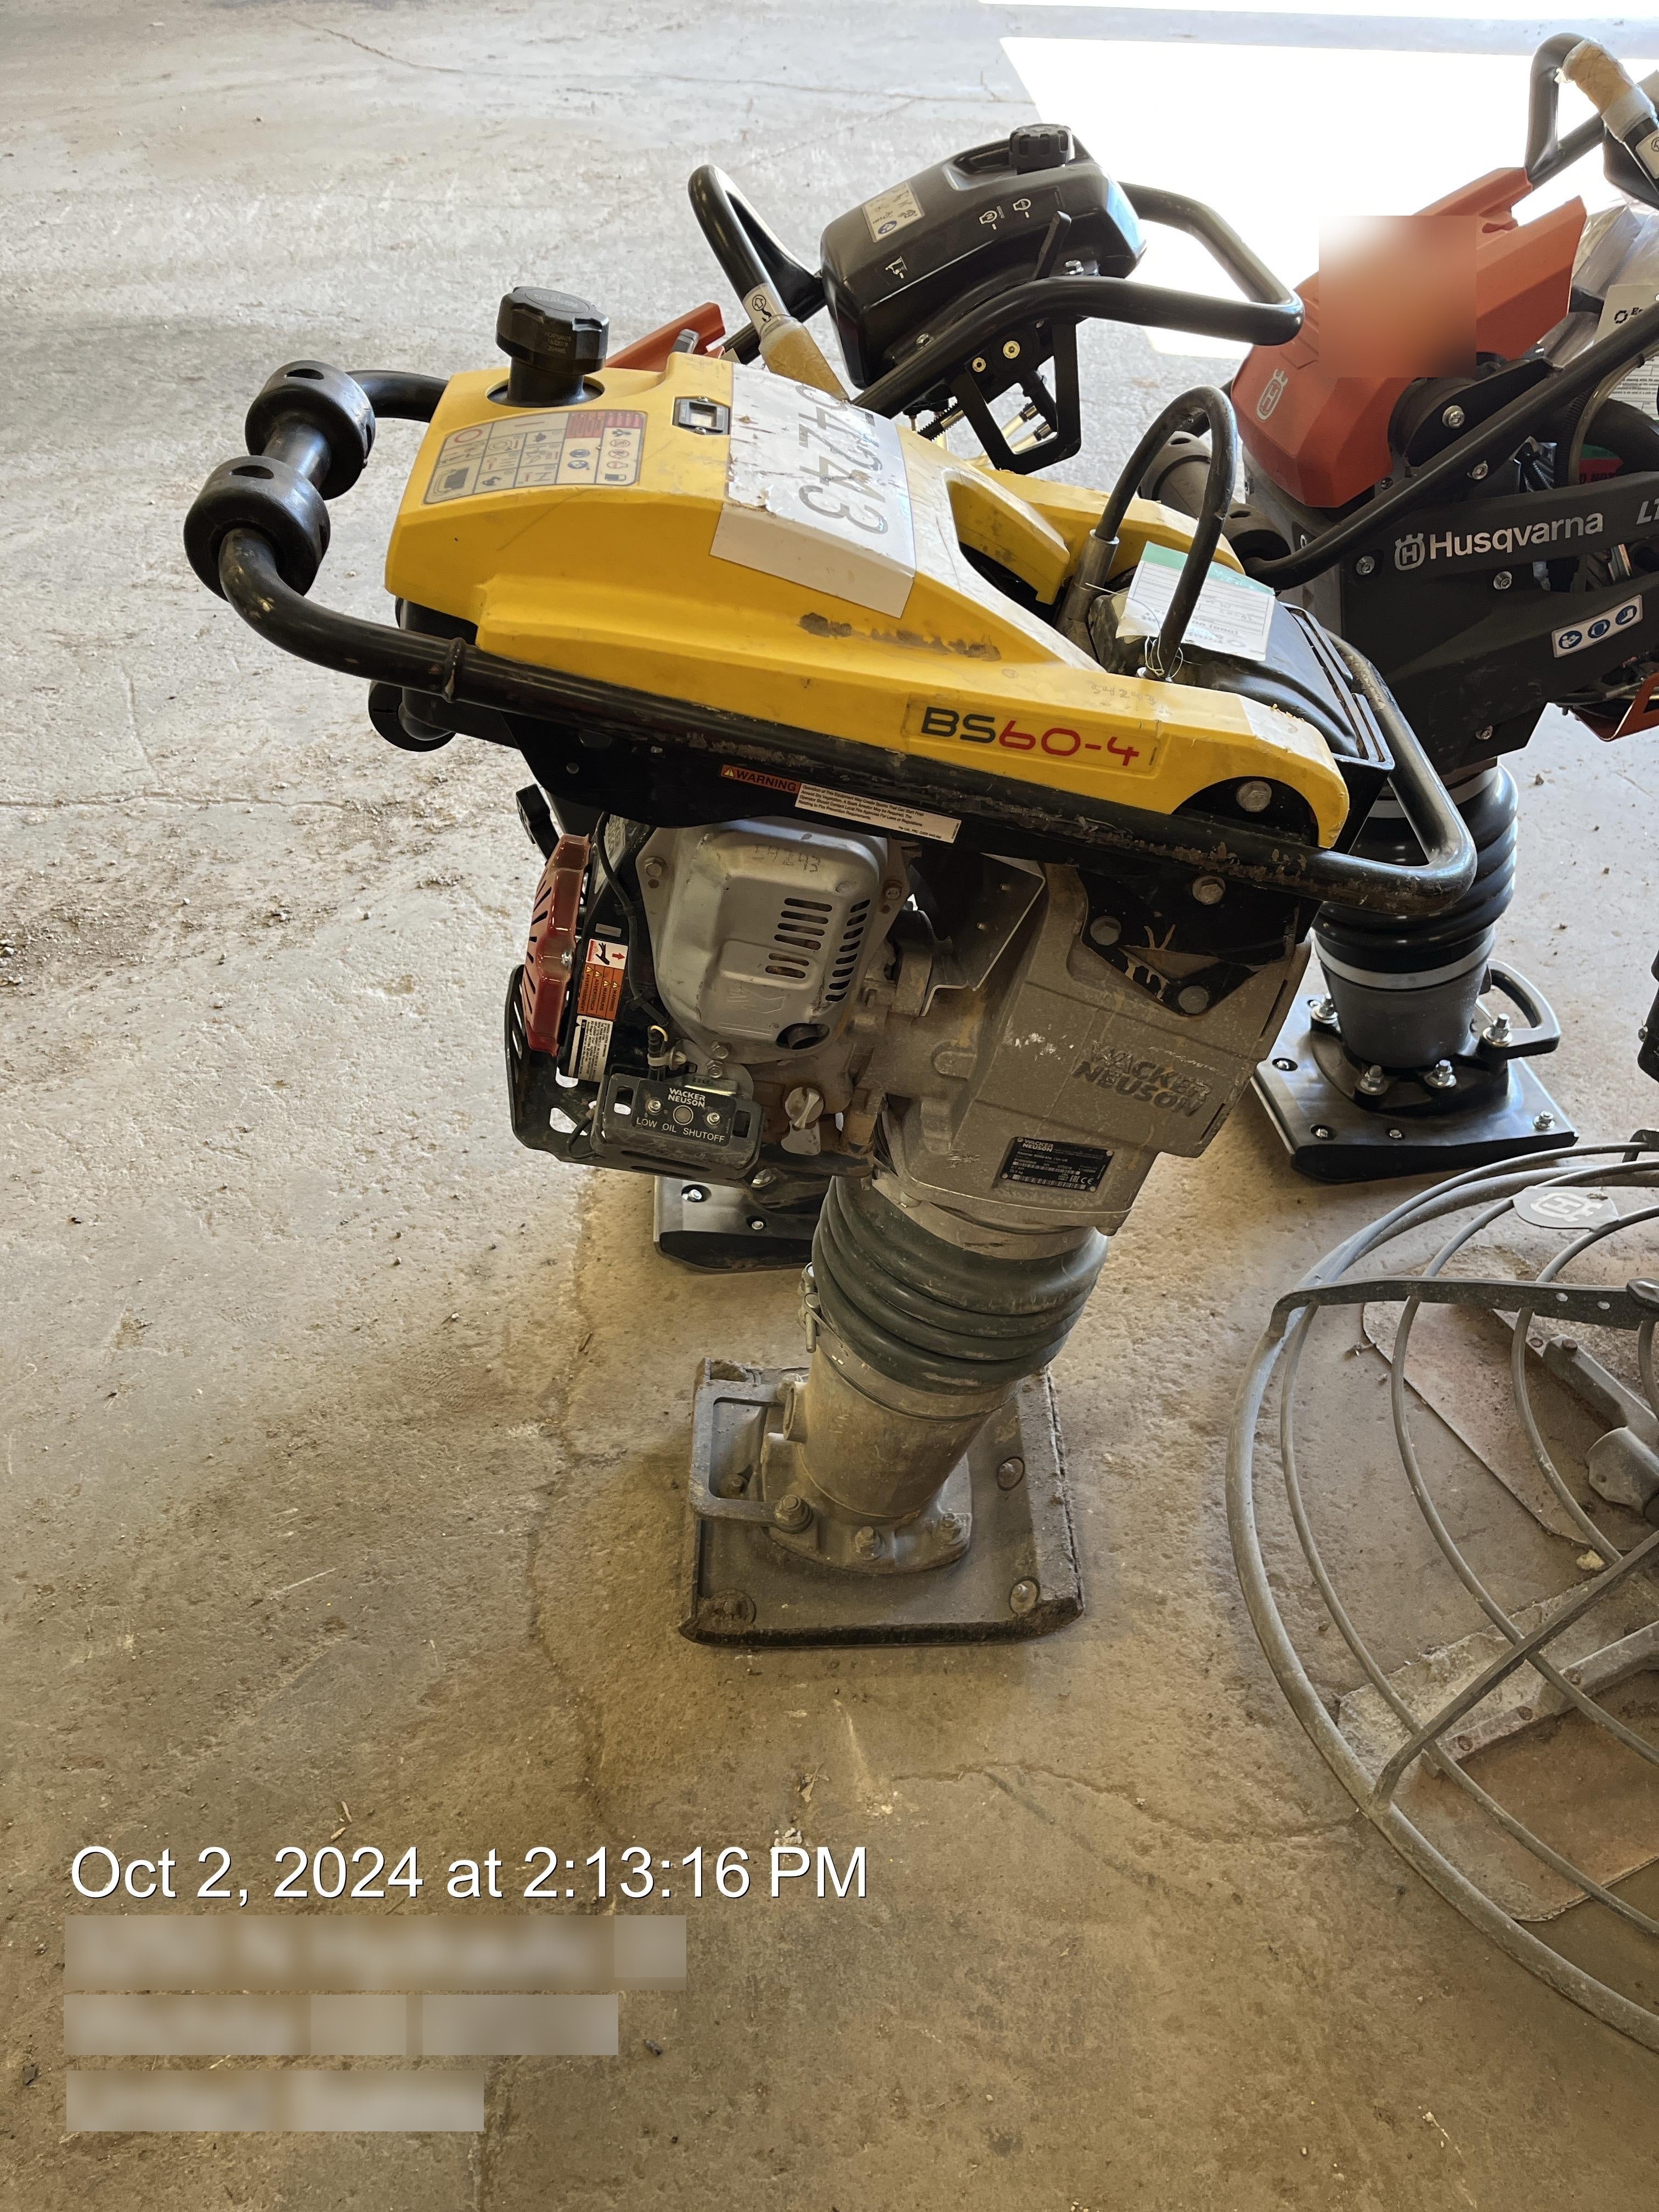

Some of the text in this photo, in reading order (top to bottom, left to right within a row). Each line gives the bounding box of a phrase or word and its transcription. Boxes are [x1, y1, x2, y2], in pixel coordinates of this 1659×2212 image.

[1430, 512, 1603, 560] Husqvarna
[921, 706, 1139, 766] BS60-4
[736, 770, 797, 791] WARNING
[668, 1094, 706, 1108] NEUSON
[669, 1087, 706, 1102] WACKER
[636, 1117, 725, 1143] LOW OIL SHUTOFF
[1022, 1142, 1053, 1152] NEUSON
[1024, 1139, 1053, 1149] WACKER
